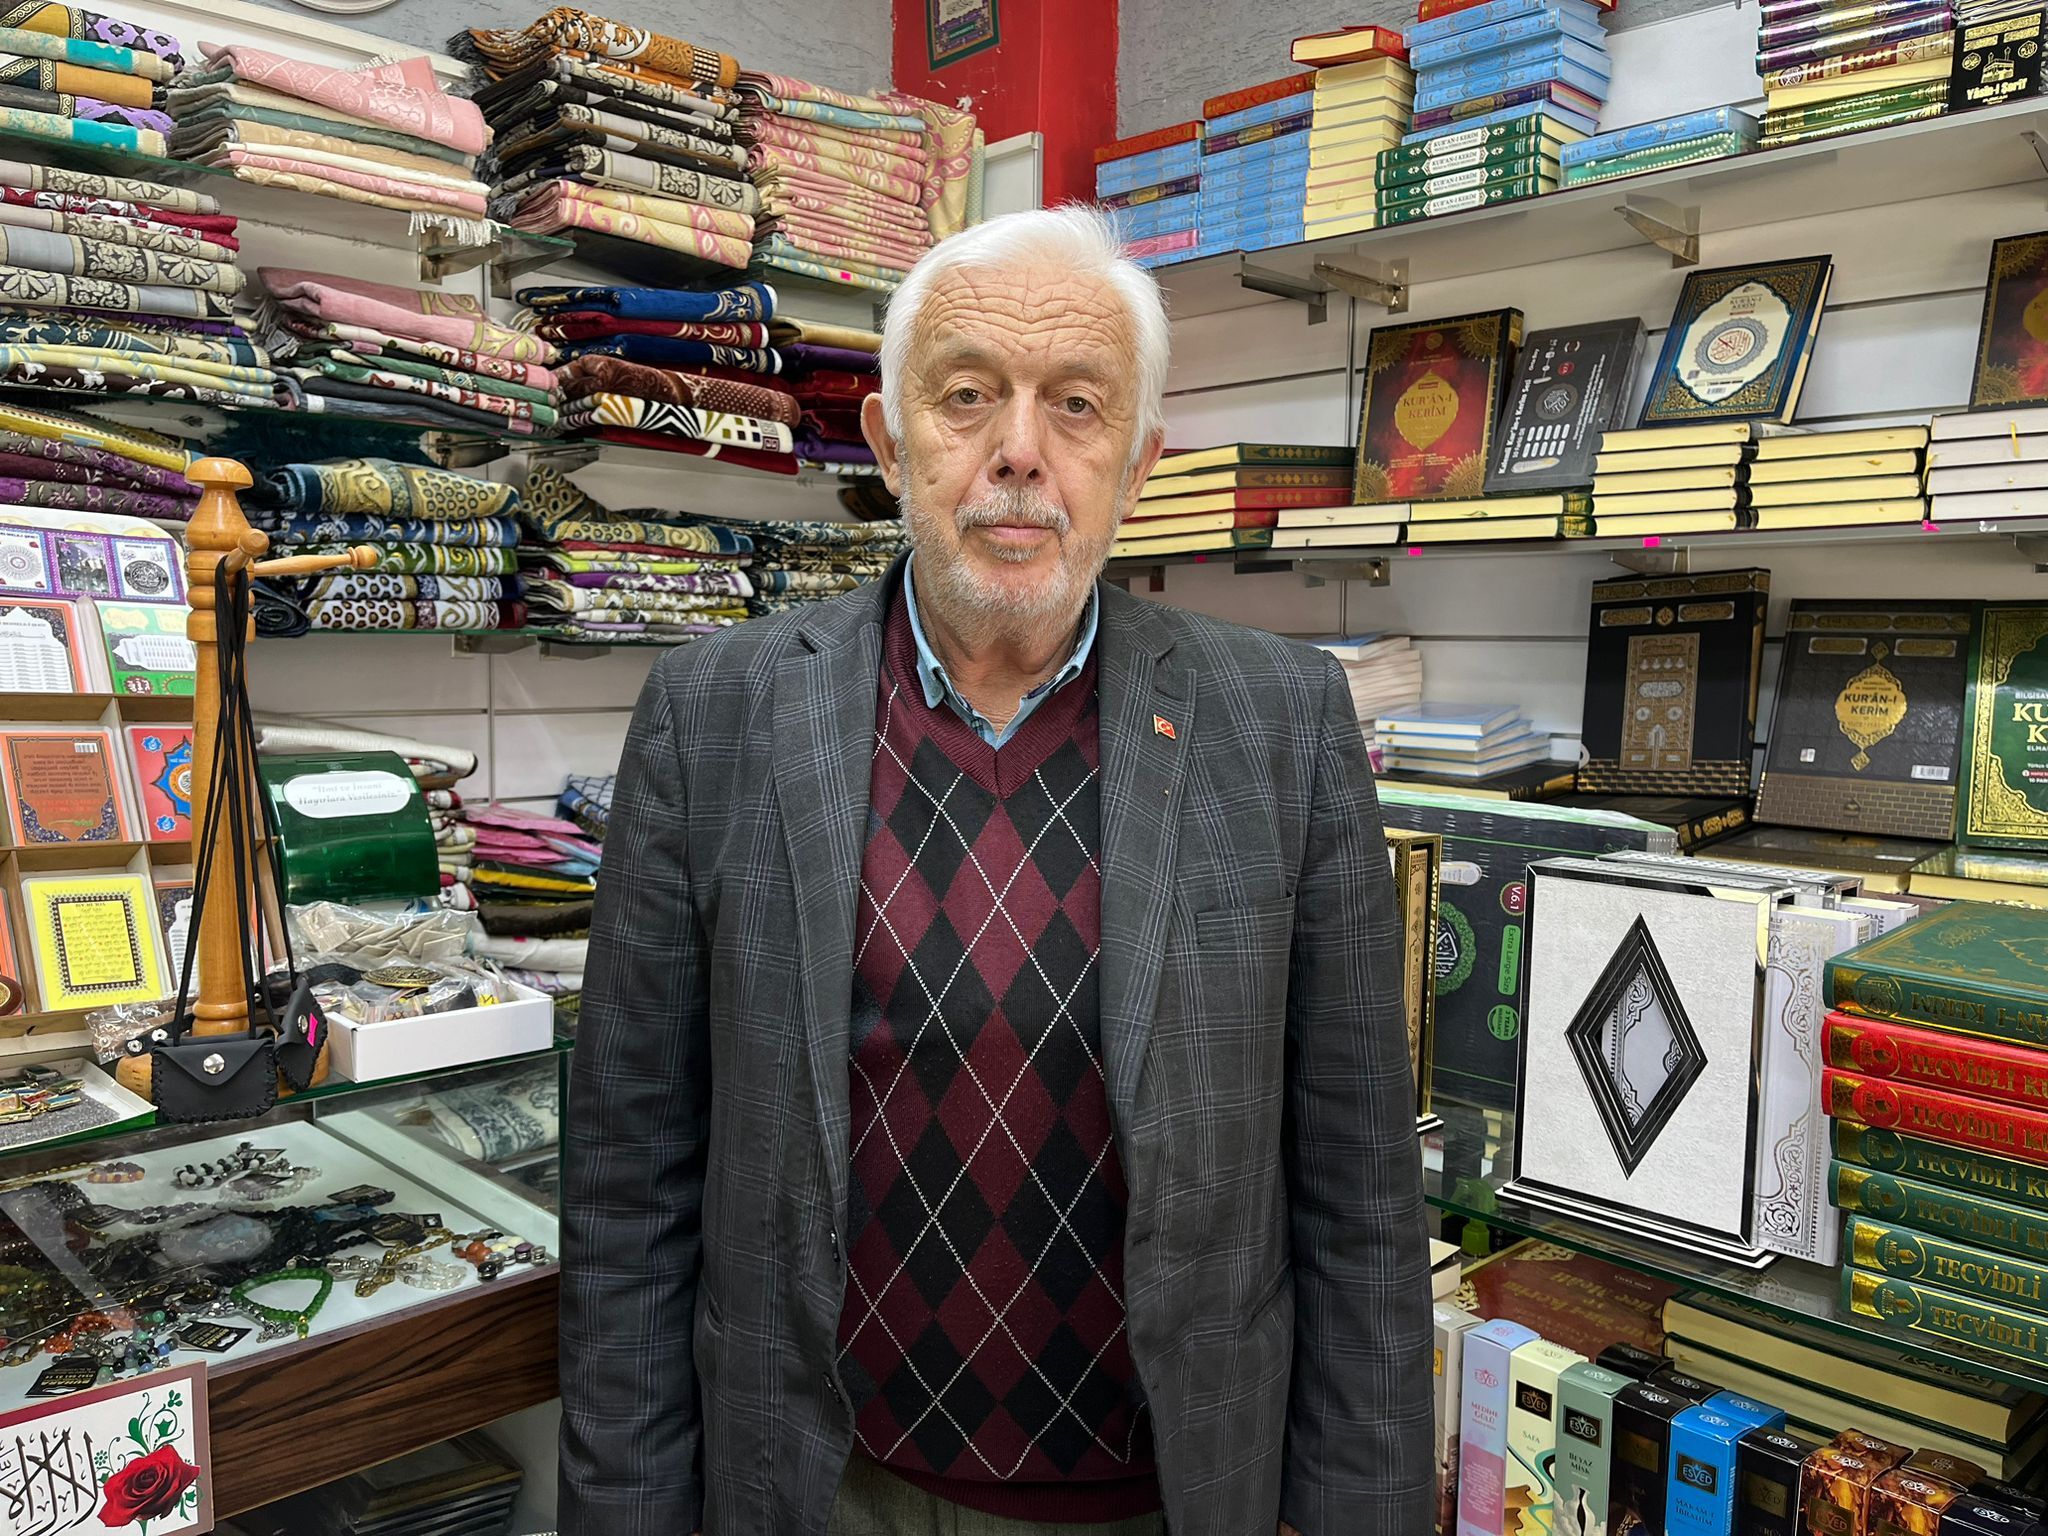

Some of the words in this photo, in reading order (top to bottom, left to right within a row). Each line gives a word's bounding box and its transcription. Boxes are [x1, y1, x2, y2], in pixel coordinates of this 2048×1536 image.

[1408, 405, 1446, 419] KERİM
[1843, 692, 1897, 705] KUR'ÂN-I
[1850, 704, 1889, 716] KERİM
[1510, 886, 1522, 910] V.6.1
[1507, 927, 1517, 949] Extra
[1504, 950, 1515, 974] Large
[1503, 976, 1513, 993] Size
[1909, 1054, 2016, 1092] TECVİDLİ
[1910, 1104, 2015, 1145] TECVİDLİ
[1914, 1151, 2018, 1193] TECVİDLİ
[1915, 1200, 2018, 1243] TECVİDLİ
[1933, 1256, 2041, 1300] TECVİDLİ
[1930, 1306, 2037, 1351] TECVİDLİ
[40, 1378, 92, 1387] BUHARA
[1474, 1368, 1499, 1389] ESVED
[1521, 1390, 1548, 1413] ESVED
[1569, 1415, 1598, 1439] ESVED
[1766, 1434, 1798, 1450] ESVED
[1682, 1463, 1714, 1488] ESVED
[1900, 1478, 1936, 1495] ESVED
[1972, 1506, 2011, 1524] ESVED
